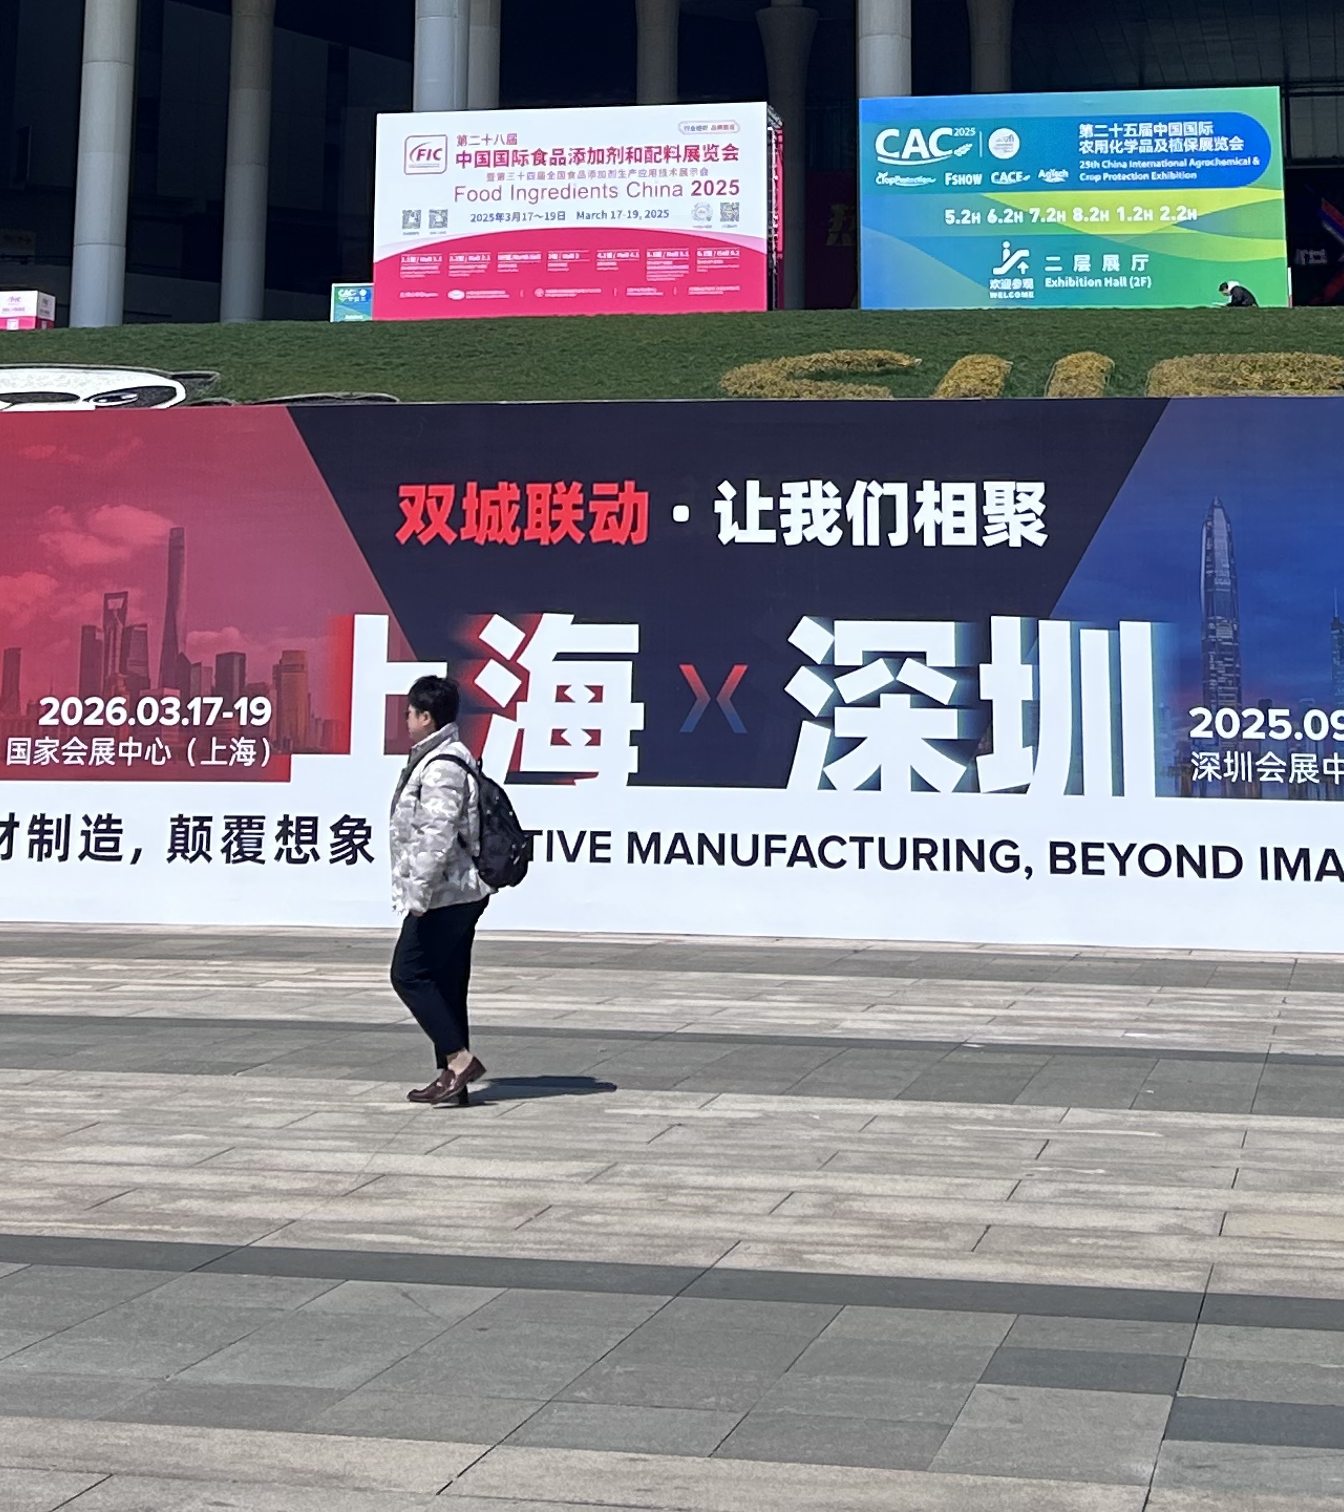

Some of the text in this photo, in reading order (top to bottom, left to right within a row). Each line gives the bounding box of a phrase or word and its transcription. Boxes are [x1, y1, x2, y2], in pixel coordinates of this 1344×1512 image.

[1079, 121, 1213, 138] 第二十五届中国国际
[456, 133, 518, 147] 第二十八届
[875, 127, 976, 161] CAC 2025
[1079, 136, 1244, 154] 农用化学品及植保展览会
[415, 147, 443, 161] FIC
[455, 143, 740, 169] 中国国际食品添加剂和配料展览会
[1102, 159, 1127, 169] China
[1129, 158, 1186, 169] International
[1189, 156, 1251, 168] Agrochemical
[945, 172, 983, 186] FSHOW
[1103, 171, 1149, 181] Protection
[1151, 170, 1197, 181] Exhibition
[454, 179, 740, 205] Food Ingredients China 2025
[576, 209, 670, 220] March 17-19, 2025
[944, 205, 1198, 225] 5.2H 6.2H 7.2H 8.2H 1.2H 2.2H
[1044, 254, 1149, 273] 二层展厅
[1044, 275, 1152, 289] Exhibition Hall (2F)
[989, 291, 1034, 299] WELCOME
[38, 696, 272, 728] 2026.03.17-19
[346, 612, 644, 786] 上海
[785, 615, 1161, 798] 深圳
[5, 737, 272, 769] 国家会展中心（上海）
[627, 831, 1033, 880] MANUFACTURING,
[1049, 840, 1243, 881] BEYOND
